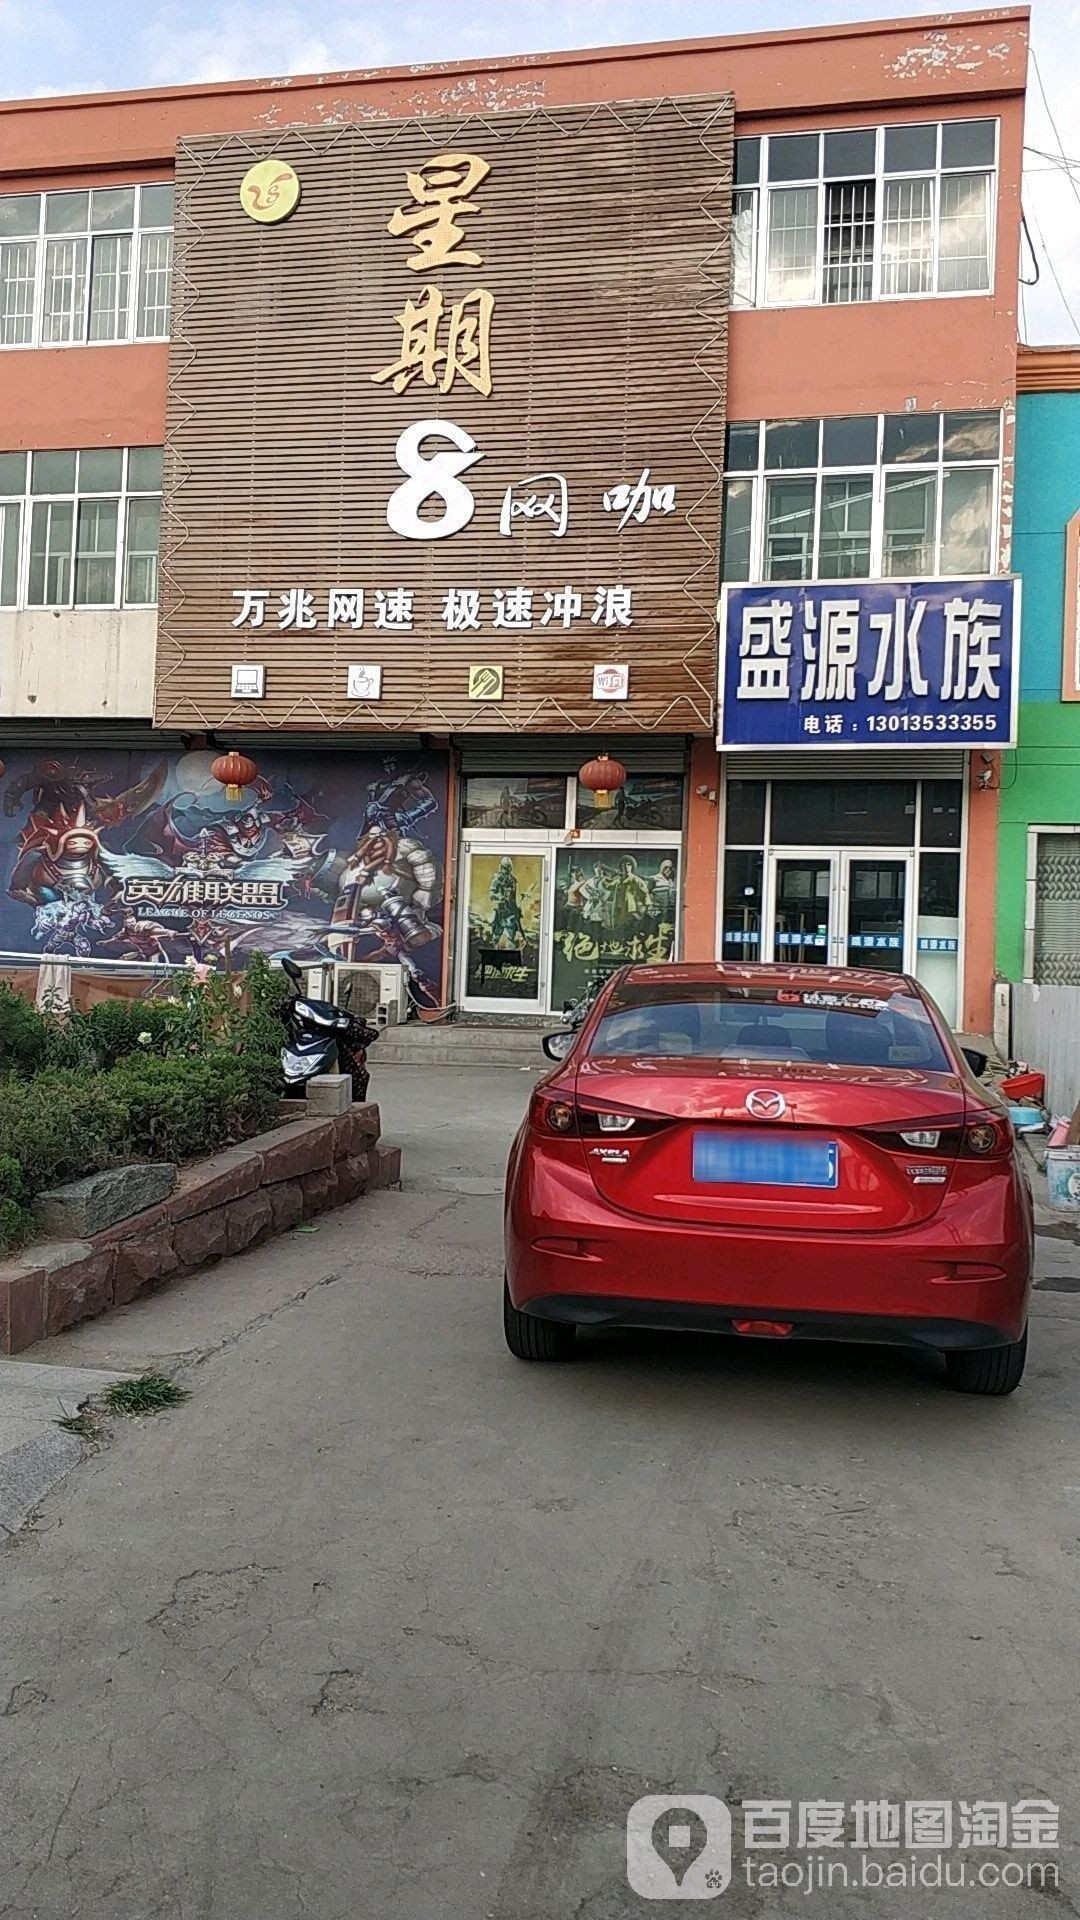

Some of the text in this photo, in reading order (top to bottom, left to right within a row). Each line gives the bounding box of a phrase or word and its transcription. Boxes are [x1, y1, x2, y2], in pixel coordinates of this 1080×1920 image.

[230, 584, 636, 631] 万兆网速 极速冲浪
[736, 597, 1002, 701] 盛源水族
[127, 874, 282, 906] 英雄联盟
[138, 906, 188, 918] LEAGUE
[191, 907, 207, 919] OF
